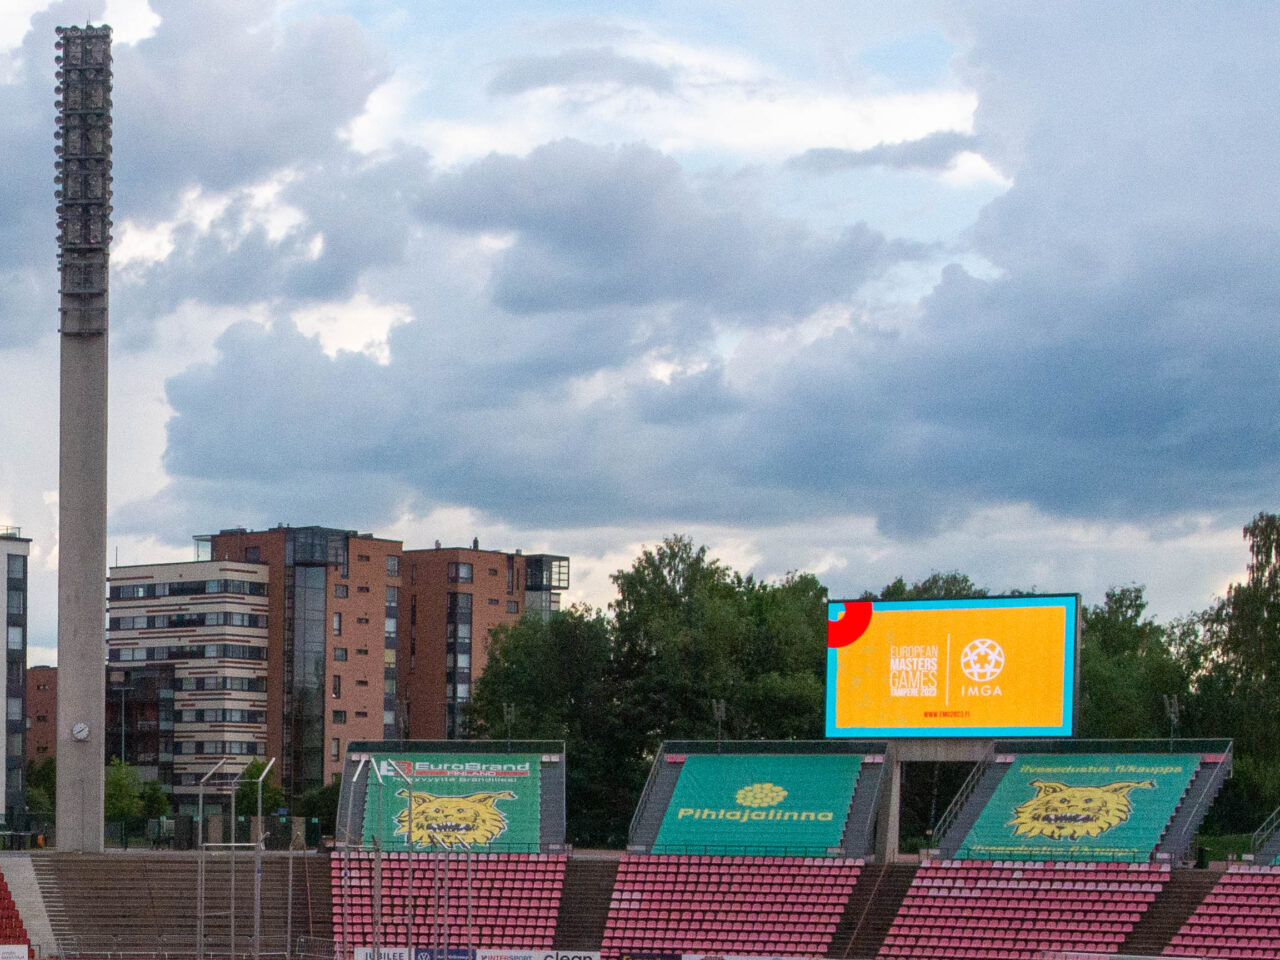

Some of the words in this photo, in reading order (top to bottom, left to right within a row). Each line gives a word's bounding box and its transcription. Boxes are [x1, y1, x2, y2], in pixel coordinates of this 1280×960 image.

[889, 645, 939, 658] EUROPEAN
[889, 657, 938, 671] MASTERS
[889, 671, 938, 689] GAMES
[889, 688, 920, 697] TAMPERE
[961, 686, 1003, 697] IMGA
[415, 762, 530, 771] EuroBrand
[677, 808, 834, 823] Pihlajalinna
